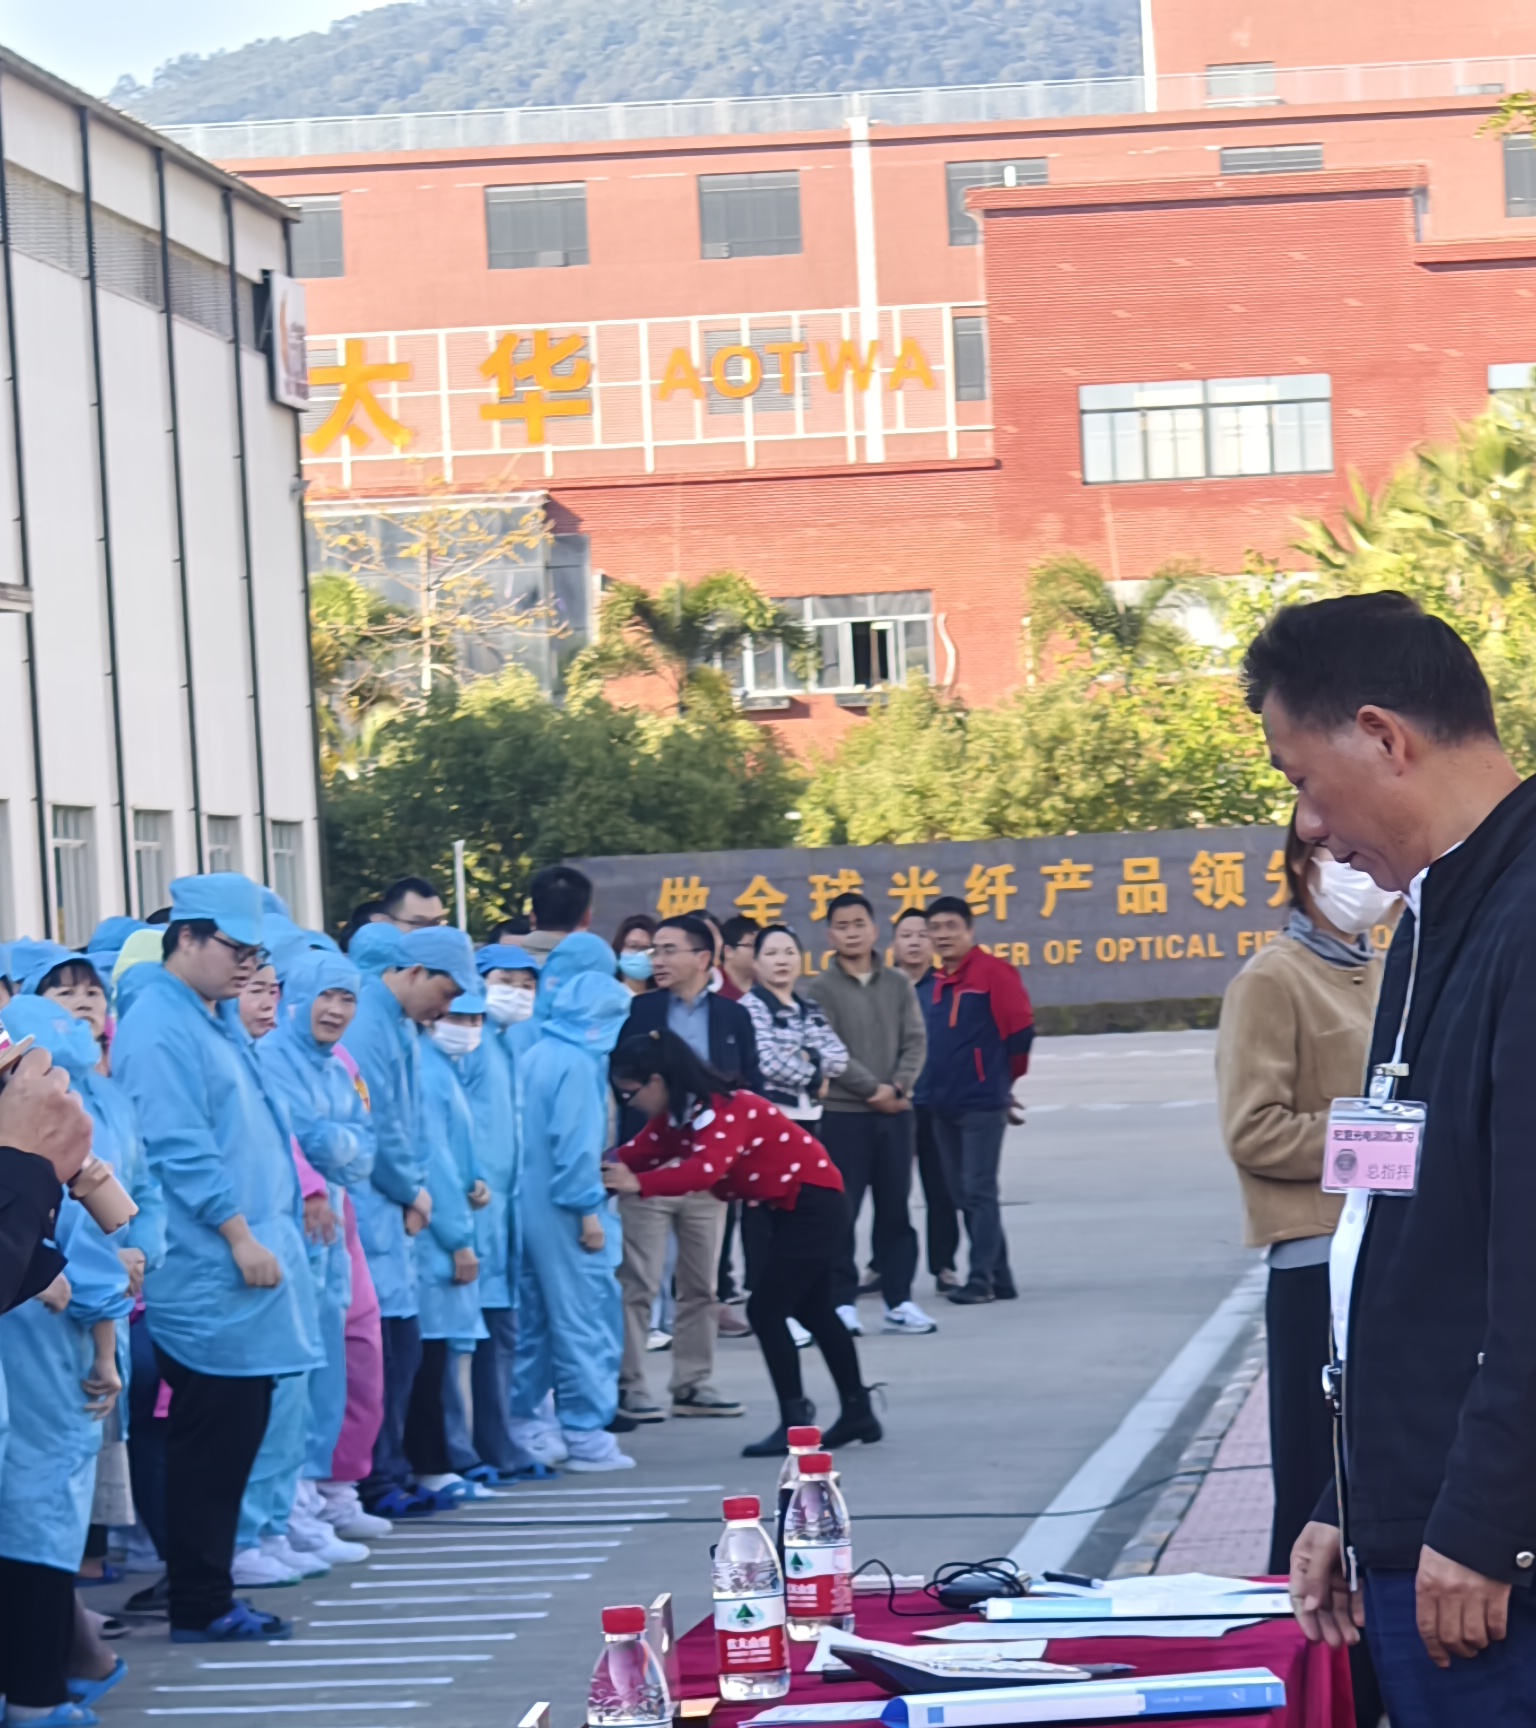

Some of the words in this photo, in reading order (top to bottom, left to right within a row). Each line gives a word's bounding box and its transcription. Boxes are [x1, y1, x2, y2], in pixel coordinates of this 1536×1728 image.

[306, 330, 593, 454] 太华
[657, 336, 936, 400] AOTWA
[1043, 939, 1083, 965] OF
[1095, 933, 1225, 962] OPTICAL
